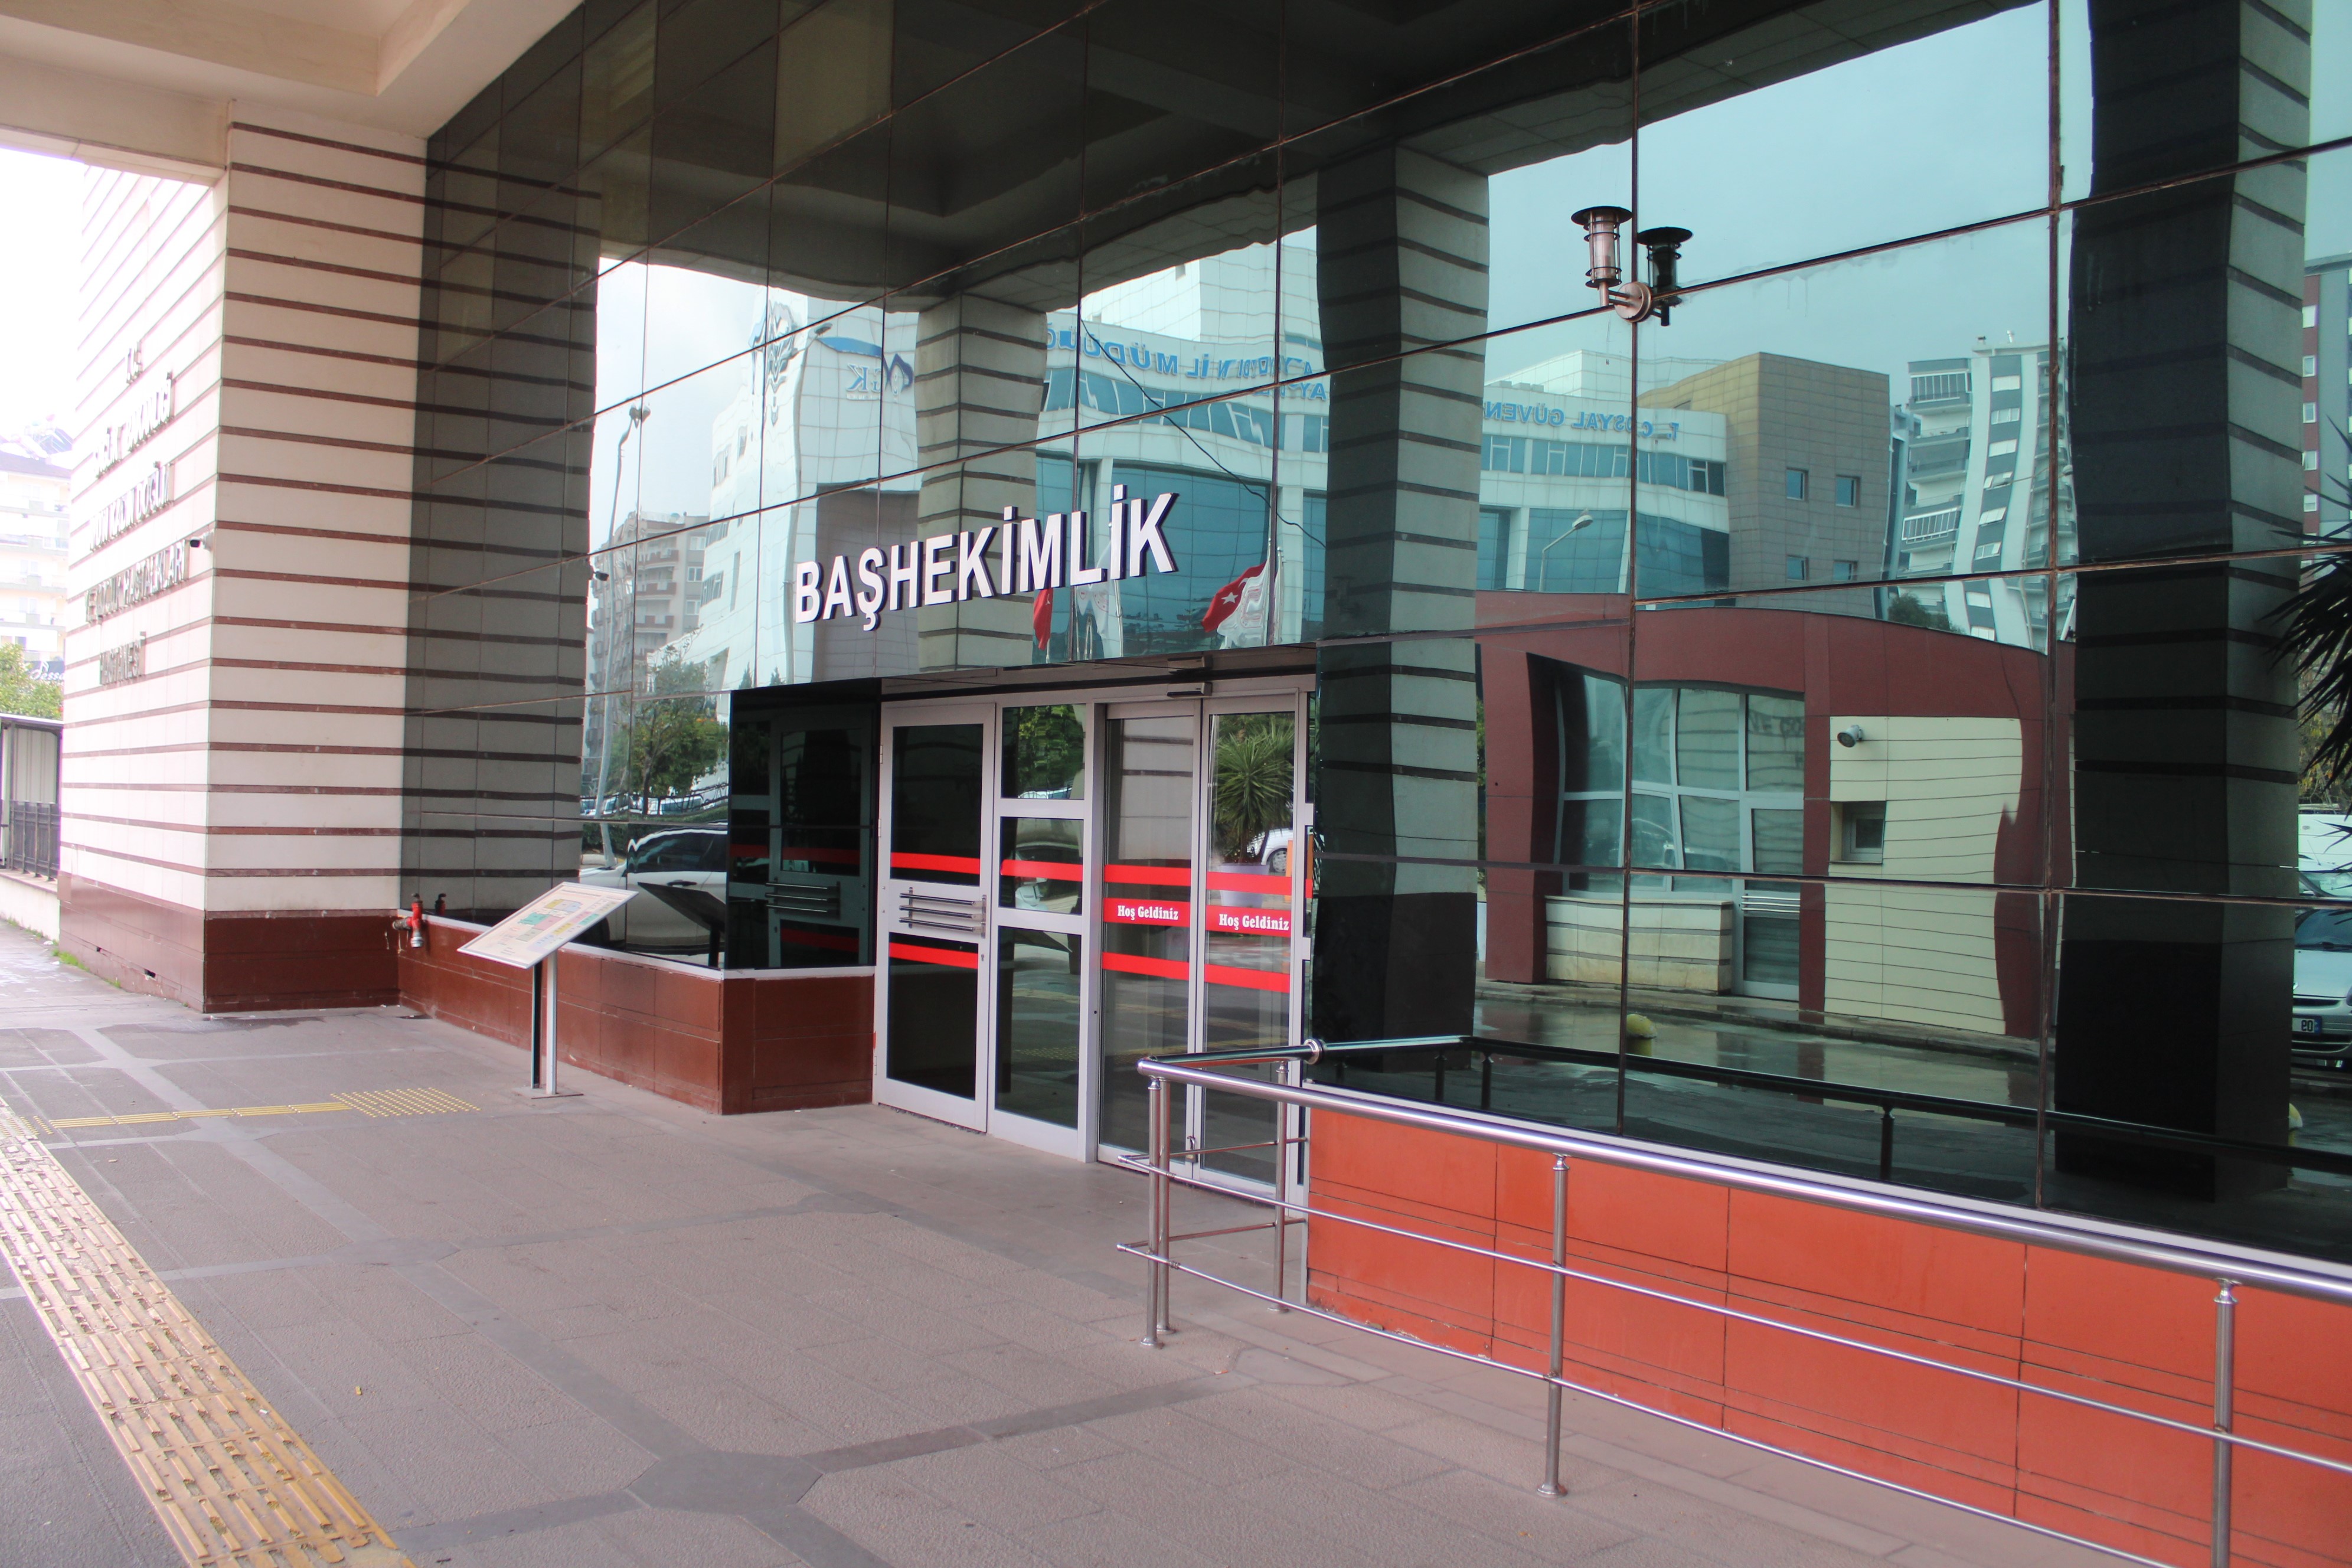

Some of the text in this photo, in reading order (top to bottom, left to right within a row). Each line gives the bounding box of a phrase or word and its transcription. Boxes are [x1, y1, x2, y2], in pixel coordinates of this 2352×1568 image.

[795, 484, 1178, 631] BAŞHEKİMLİK
[1117, 905, 1179, 921] Hoş Geldiniz
[1219, 913, 1289, 931] Hoş Geldiniz
